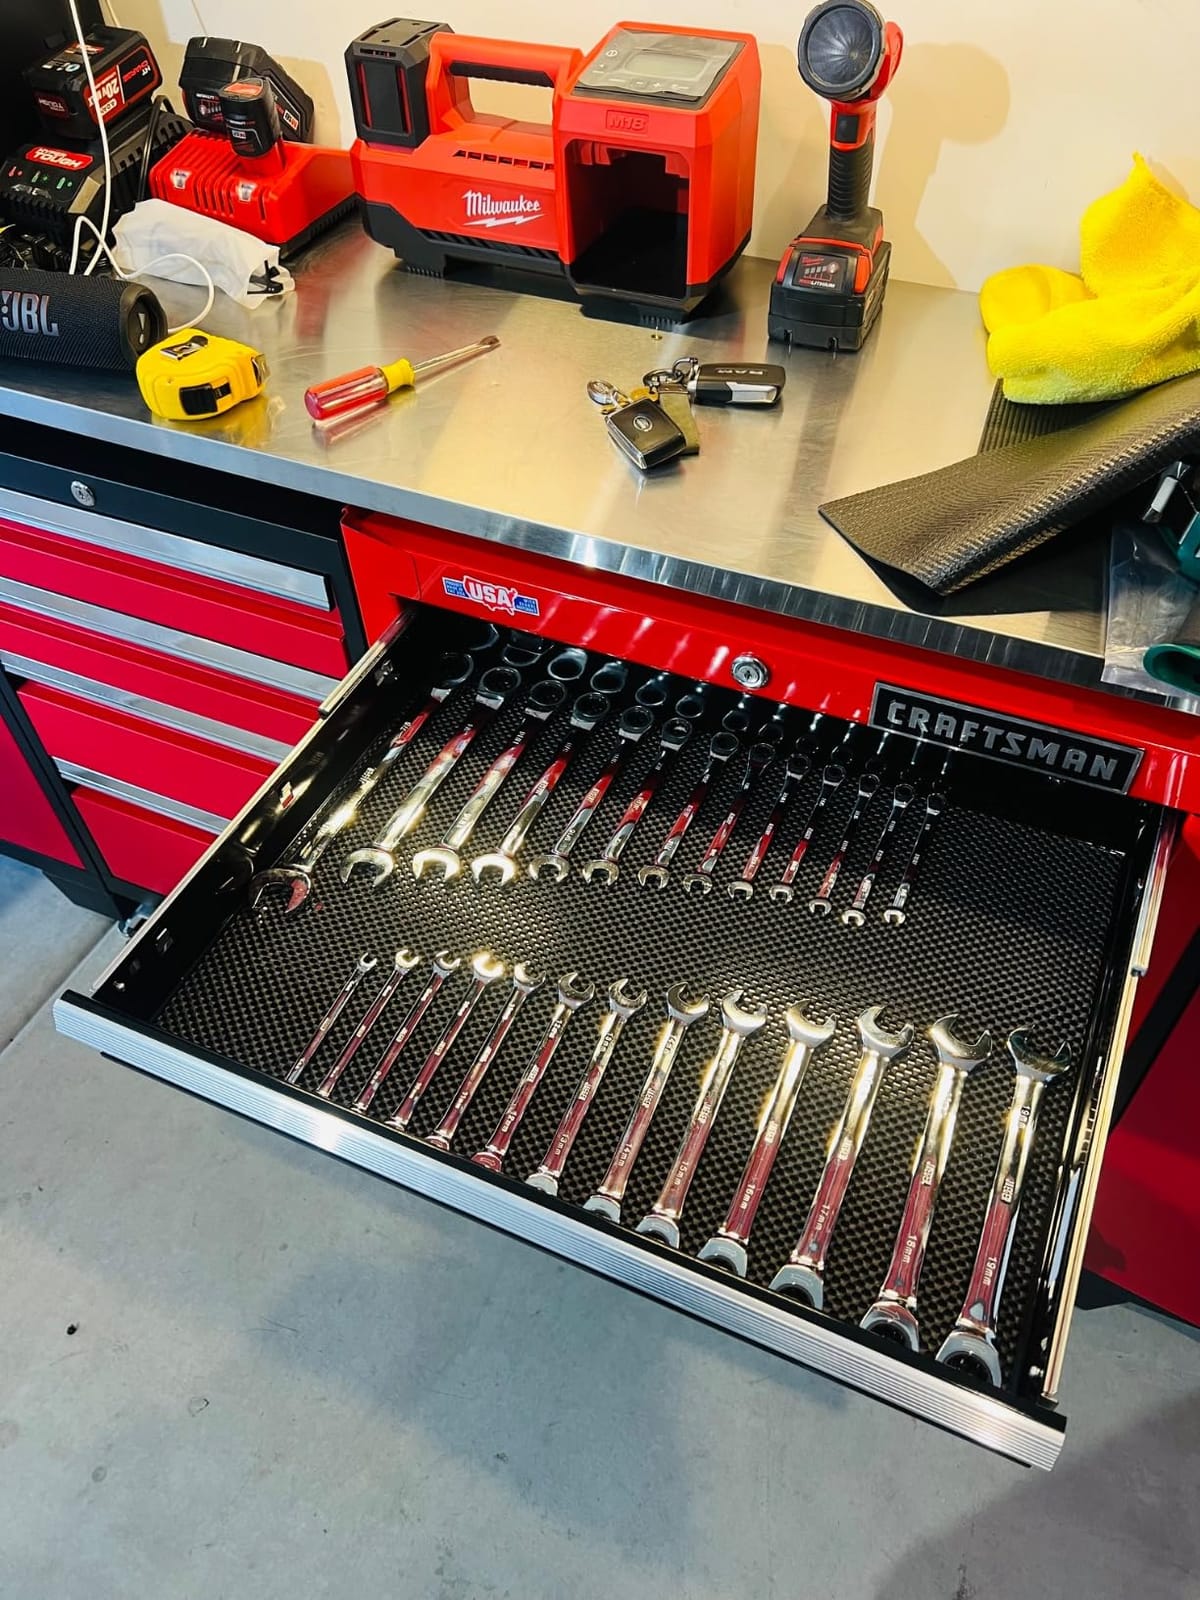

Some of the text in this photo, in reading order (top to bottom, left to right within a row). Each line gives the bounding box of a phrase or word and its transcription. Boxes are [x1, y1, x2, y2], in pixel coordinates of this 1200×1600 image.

[610, 115, 647, 131] M18
[33, 151, 82, 168] TOUGH
[462, 189, 541, 216] Milwaukee
[2, 291, 60, 337] JBL
[468, 581, 513, 608] USA
[887, 700, 1118, 781] CRAFTSMAN
[555, 1132, 569, 1156] 13mm
[617, 1143, 633, 1167] 14mm
[674, 1160, 689, 1186] 15mm
[740, 1183, 755, 1210] 16mm
[815, 1203, 831, 1231] 17mm
[901, 1233, 918, 1264] 18mm
[982, 1255, 998, 1287] 19mm
